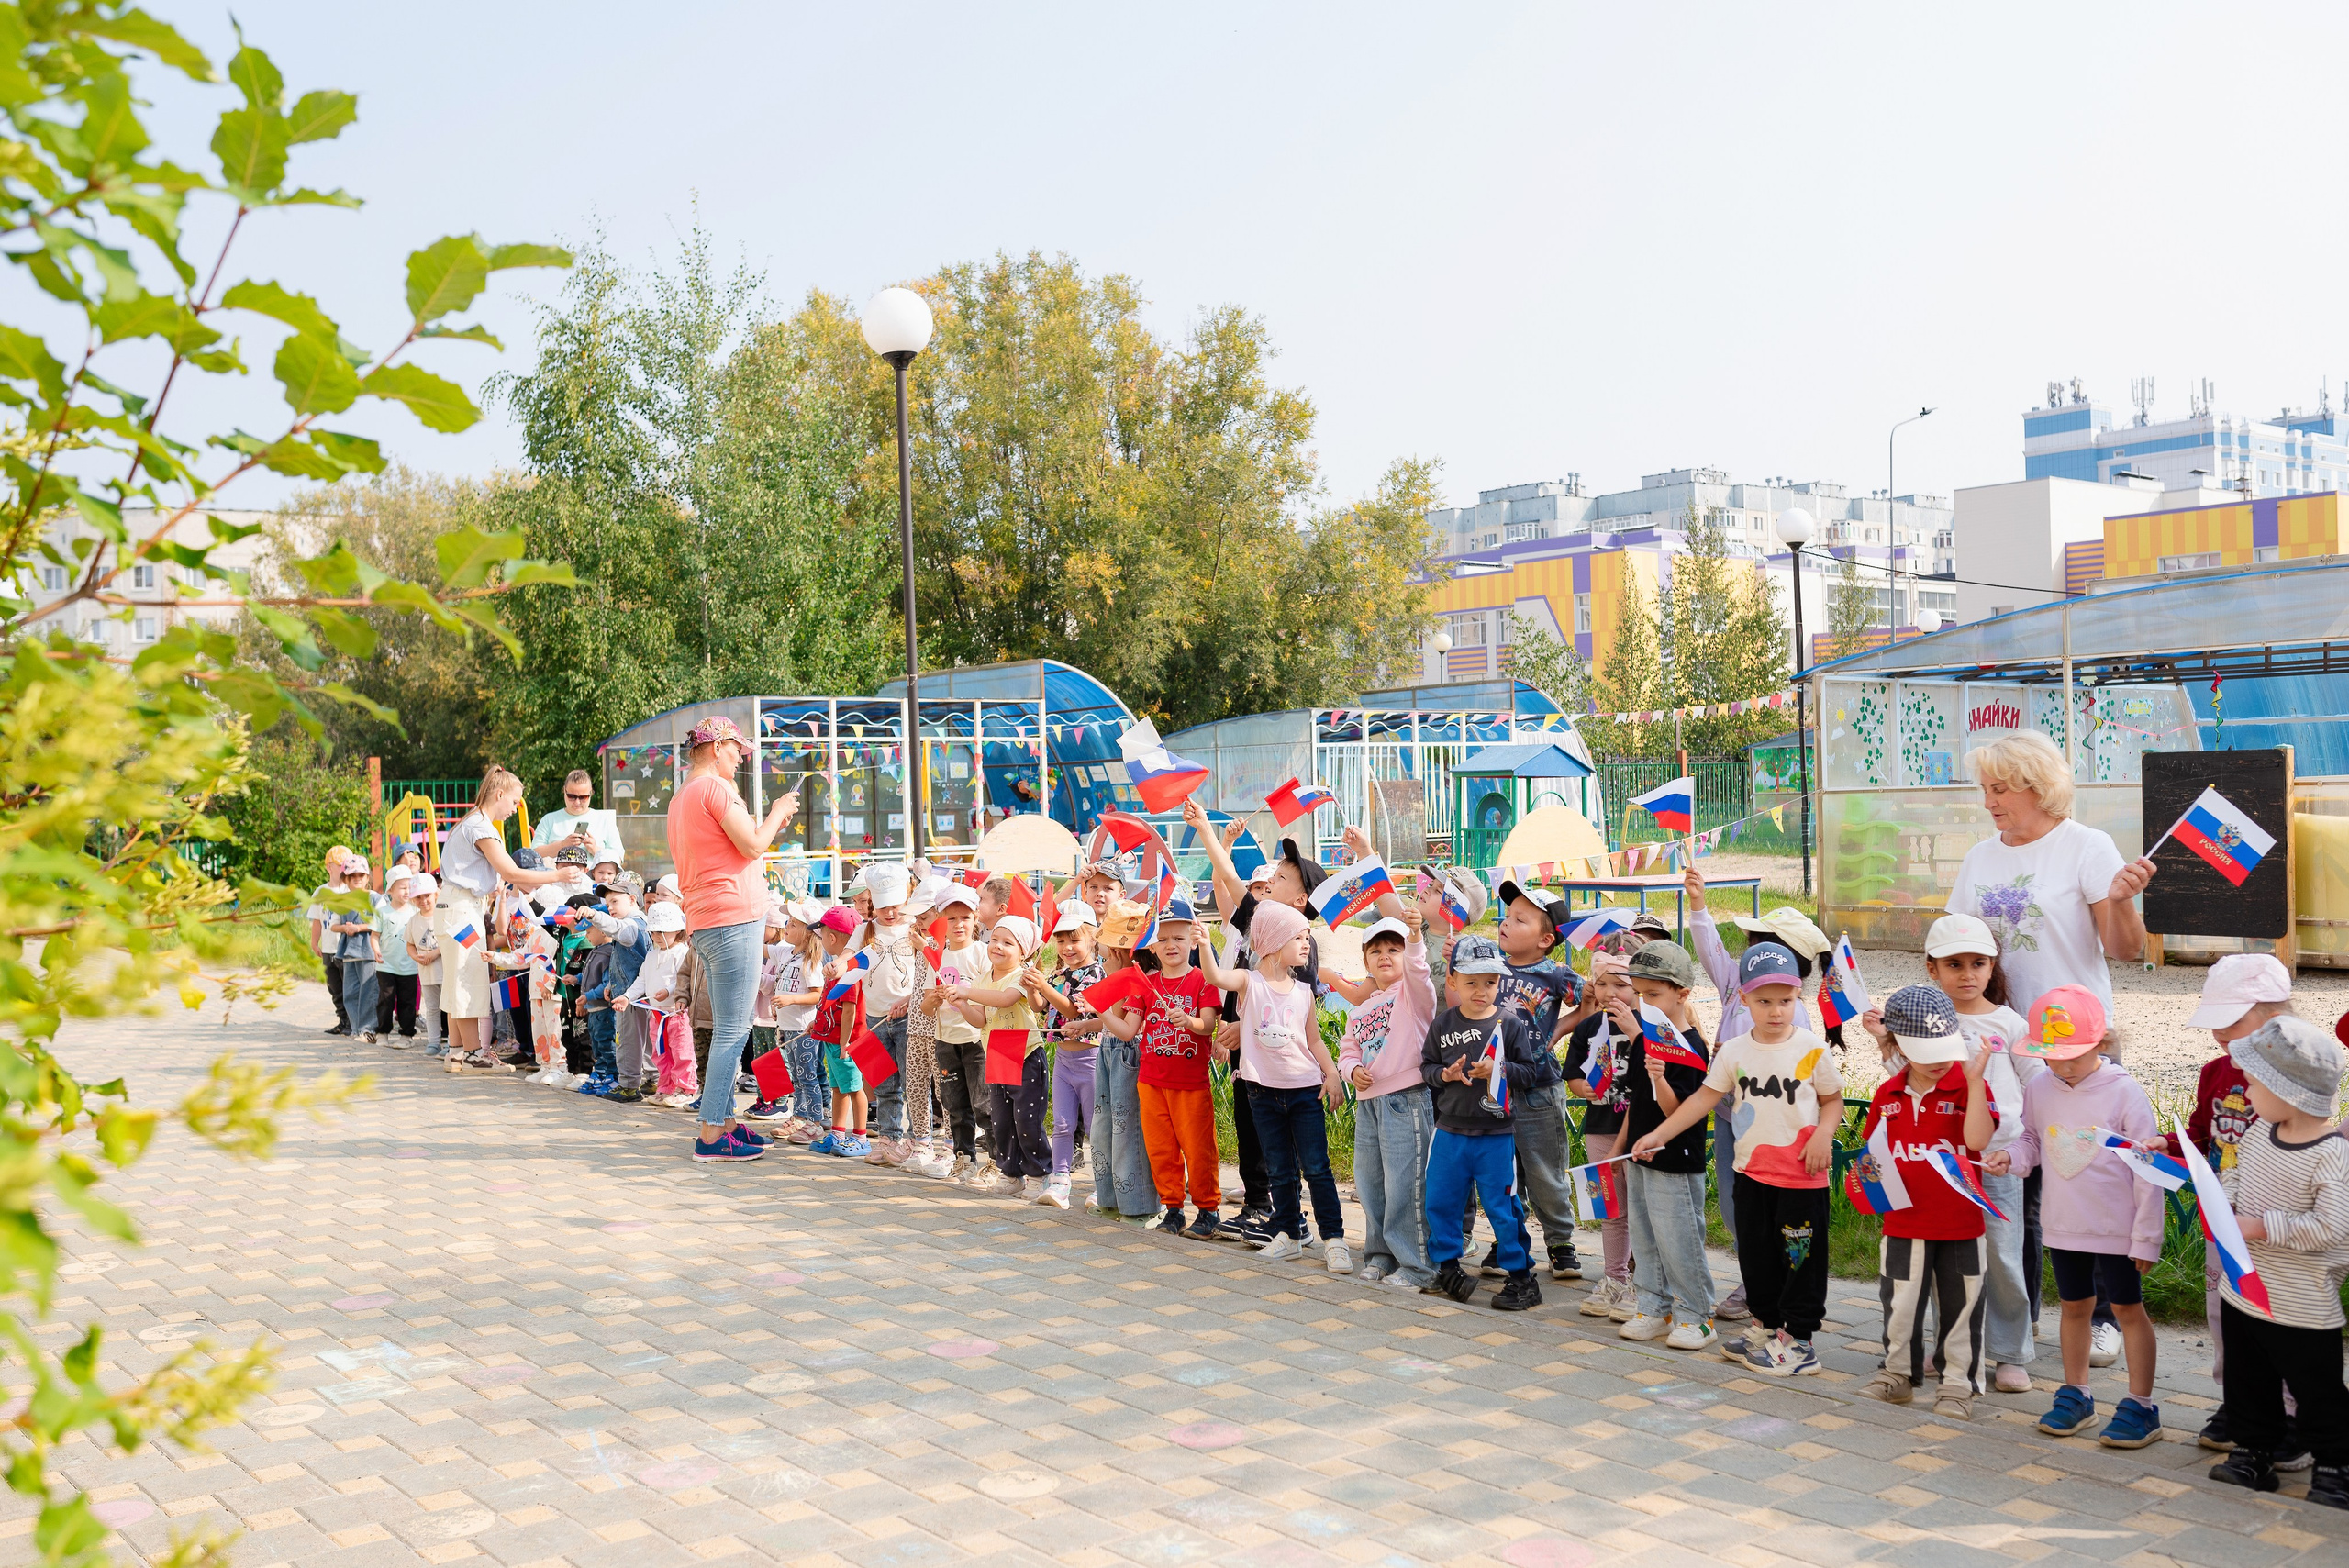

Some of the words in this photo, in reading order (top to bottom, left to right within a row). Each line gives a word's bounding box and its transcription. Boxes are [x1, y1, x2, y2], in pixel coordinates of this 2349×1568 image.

[2199, 838, 2232, 866] РОССИЯ
[1440, 1028, 1482, 1049] SUPER
[1650, 1043, 1686, 1057] РОССИЯ
[1738, 1074, 1801, 1105] PLAY
